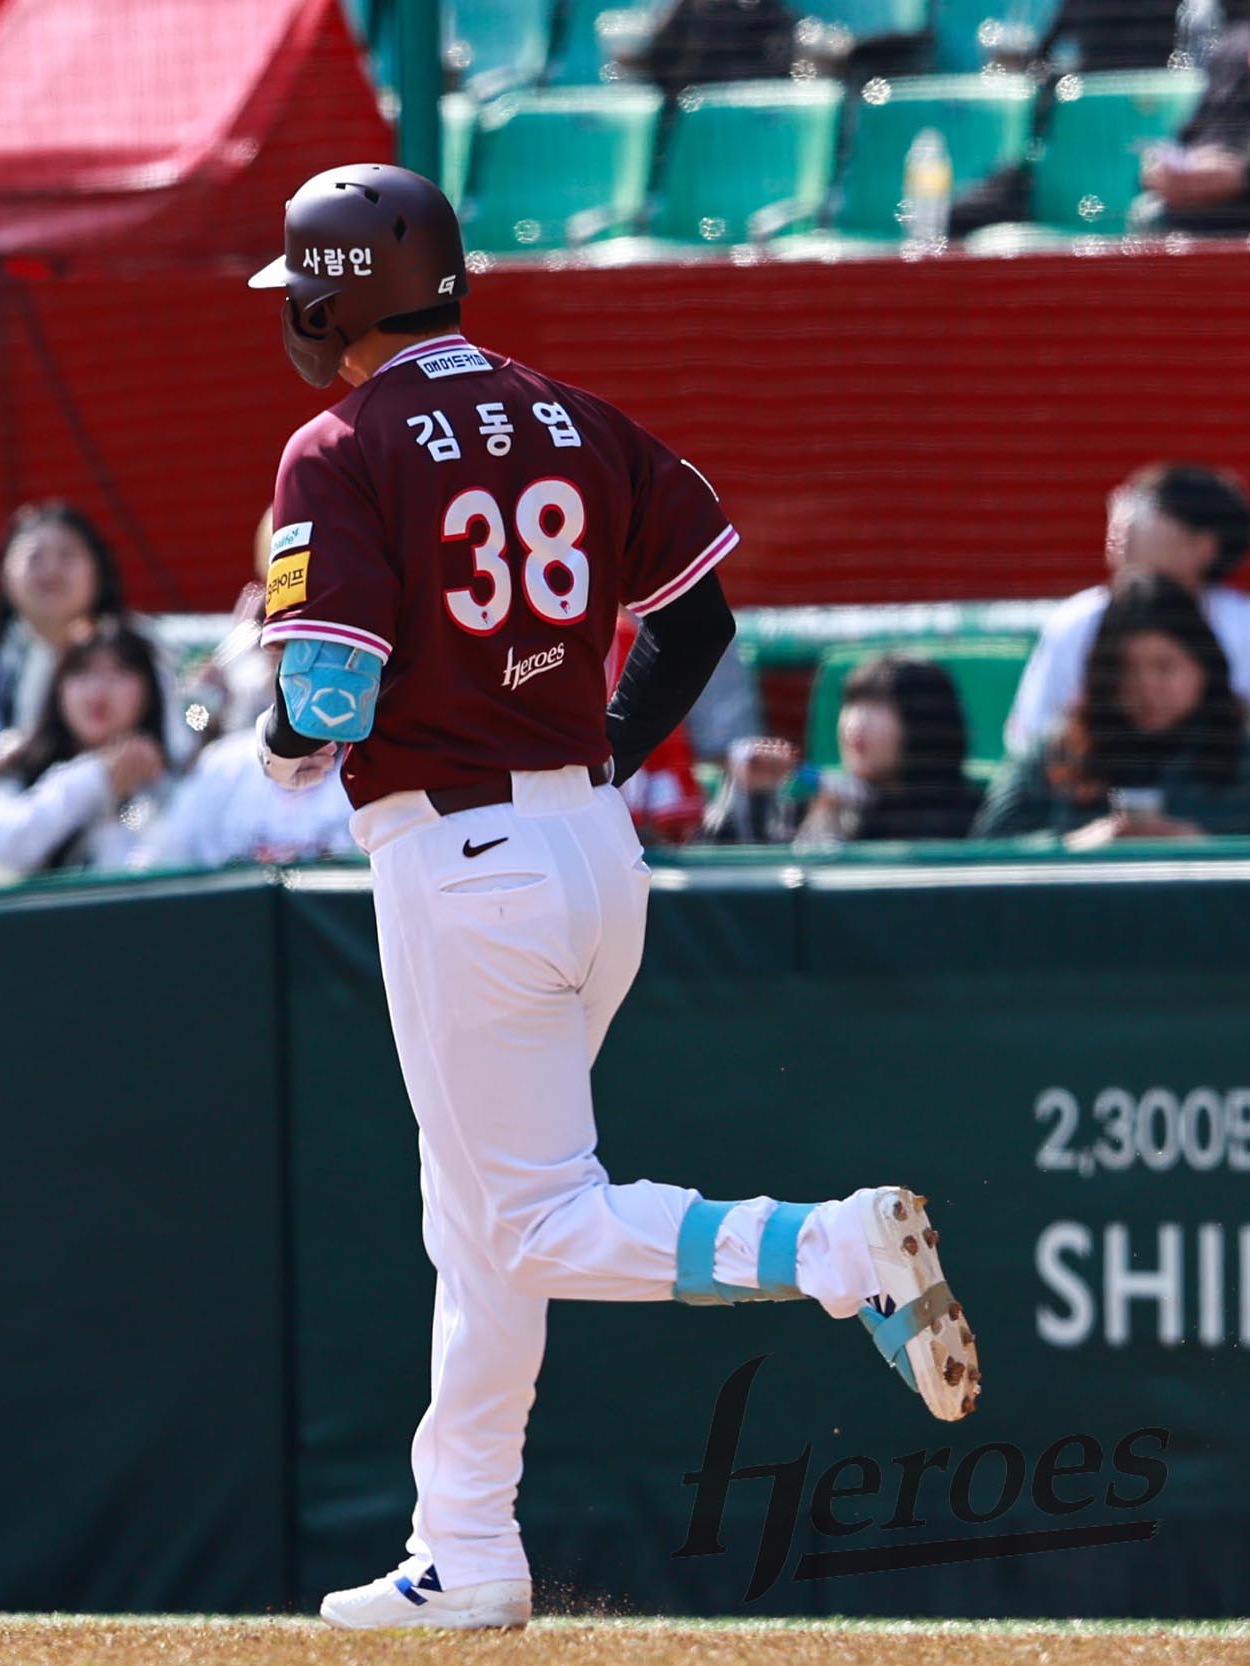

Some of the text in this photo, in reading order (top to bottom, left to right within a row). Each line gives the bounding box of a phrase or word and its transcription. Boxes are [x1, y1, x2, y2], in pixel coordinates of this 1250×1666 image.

[302, 247, 372, 277] 사람인
[267, 568, 305, 604] 라이프
[441, 476, 590, 637] 38
[1035, 1220, 1250, 1348] SHI
